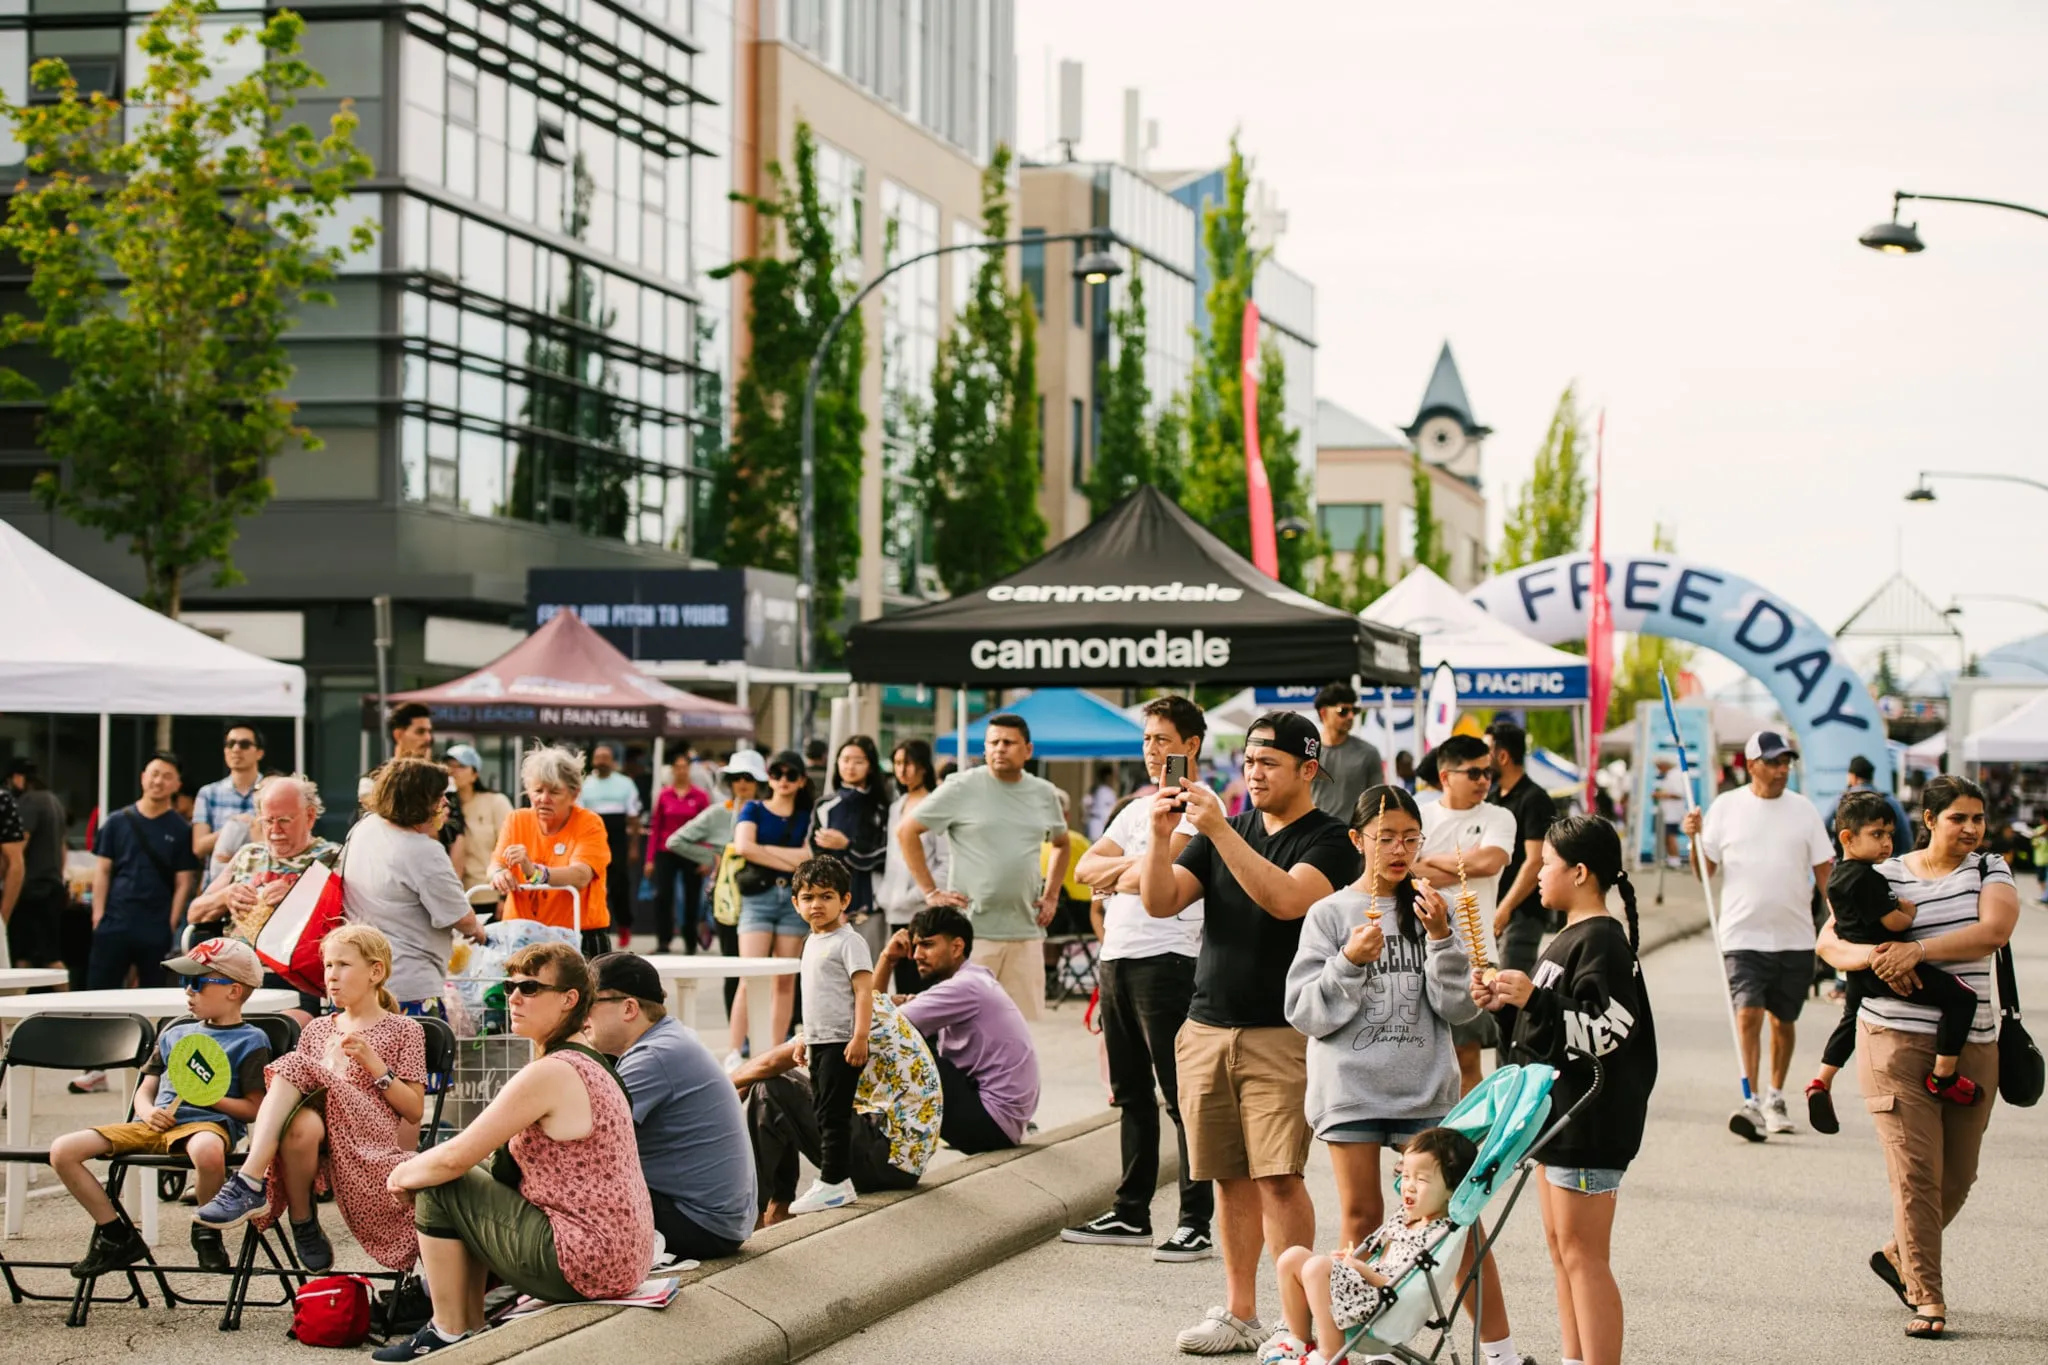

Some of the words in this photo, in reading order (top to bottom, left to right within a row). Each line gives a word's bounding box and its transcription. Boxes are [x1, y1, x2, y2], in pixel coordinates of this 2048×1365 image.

[986, 583, 1243, 603] cannondale
[658, 604, 679, 627] TO
[681, 604, 729, 627] YOURS
[970, 630, 1231, 670] cannondale
[1518, 560, 1724, 625] FREE
[1734, 599, 1870, 730] DAY
[1475, 672, 1566, 694] PACIFIC
[539, 707, 560, 725] IN
[562, 708, 650, 728] PAINTBALL
[1364, 972, 1424, 1025] 99
[190, 1058, 212, 1082] VCC
